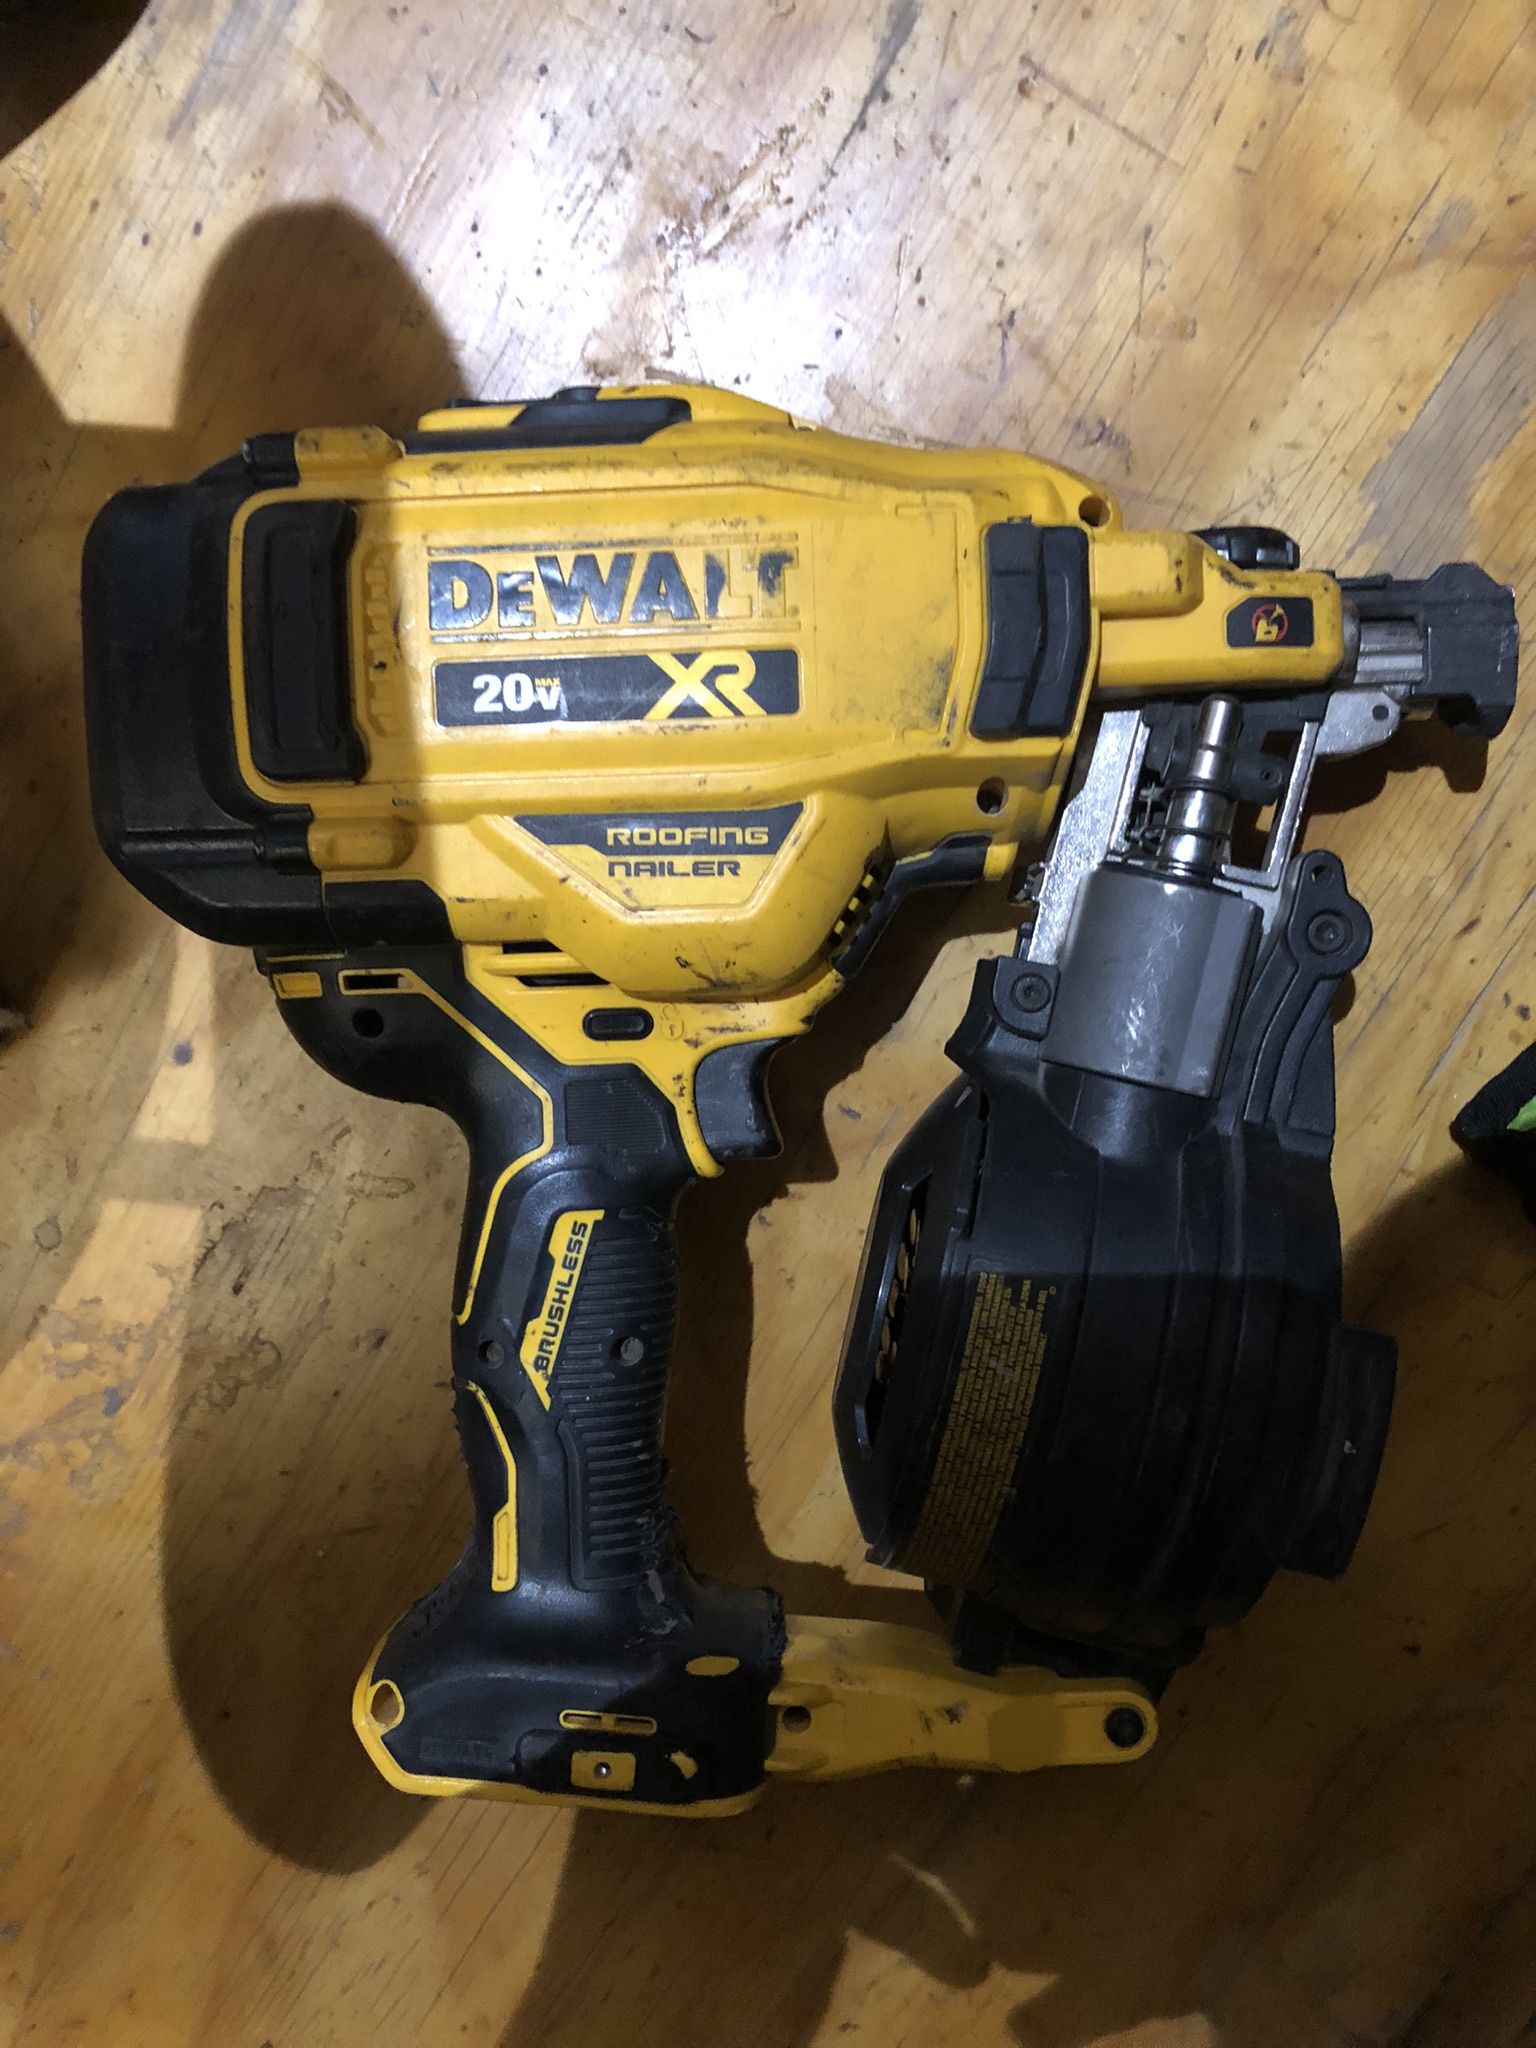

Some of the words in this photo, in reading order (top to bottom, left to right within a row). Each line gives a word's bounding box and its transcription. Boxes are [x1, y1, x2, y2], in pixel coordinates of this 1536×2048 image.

[428, 547, 798, 631] DEWALT
[535, 677, 560, 688] MAX
[643, 650, 768, 719] XR
[607, 826, 769, 847] ROOFING
[608, 860, 741, 877] NAILER
[534, 1220, 588, 1375] BRUSHLESS
